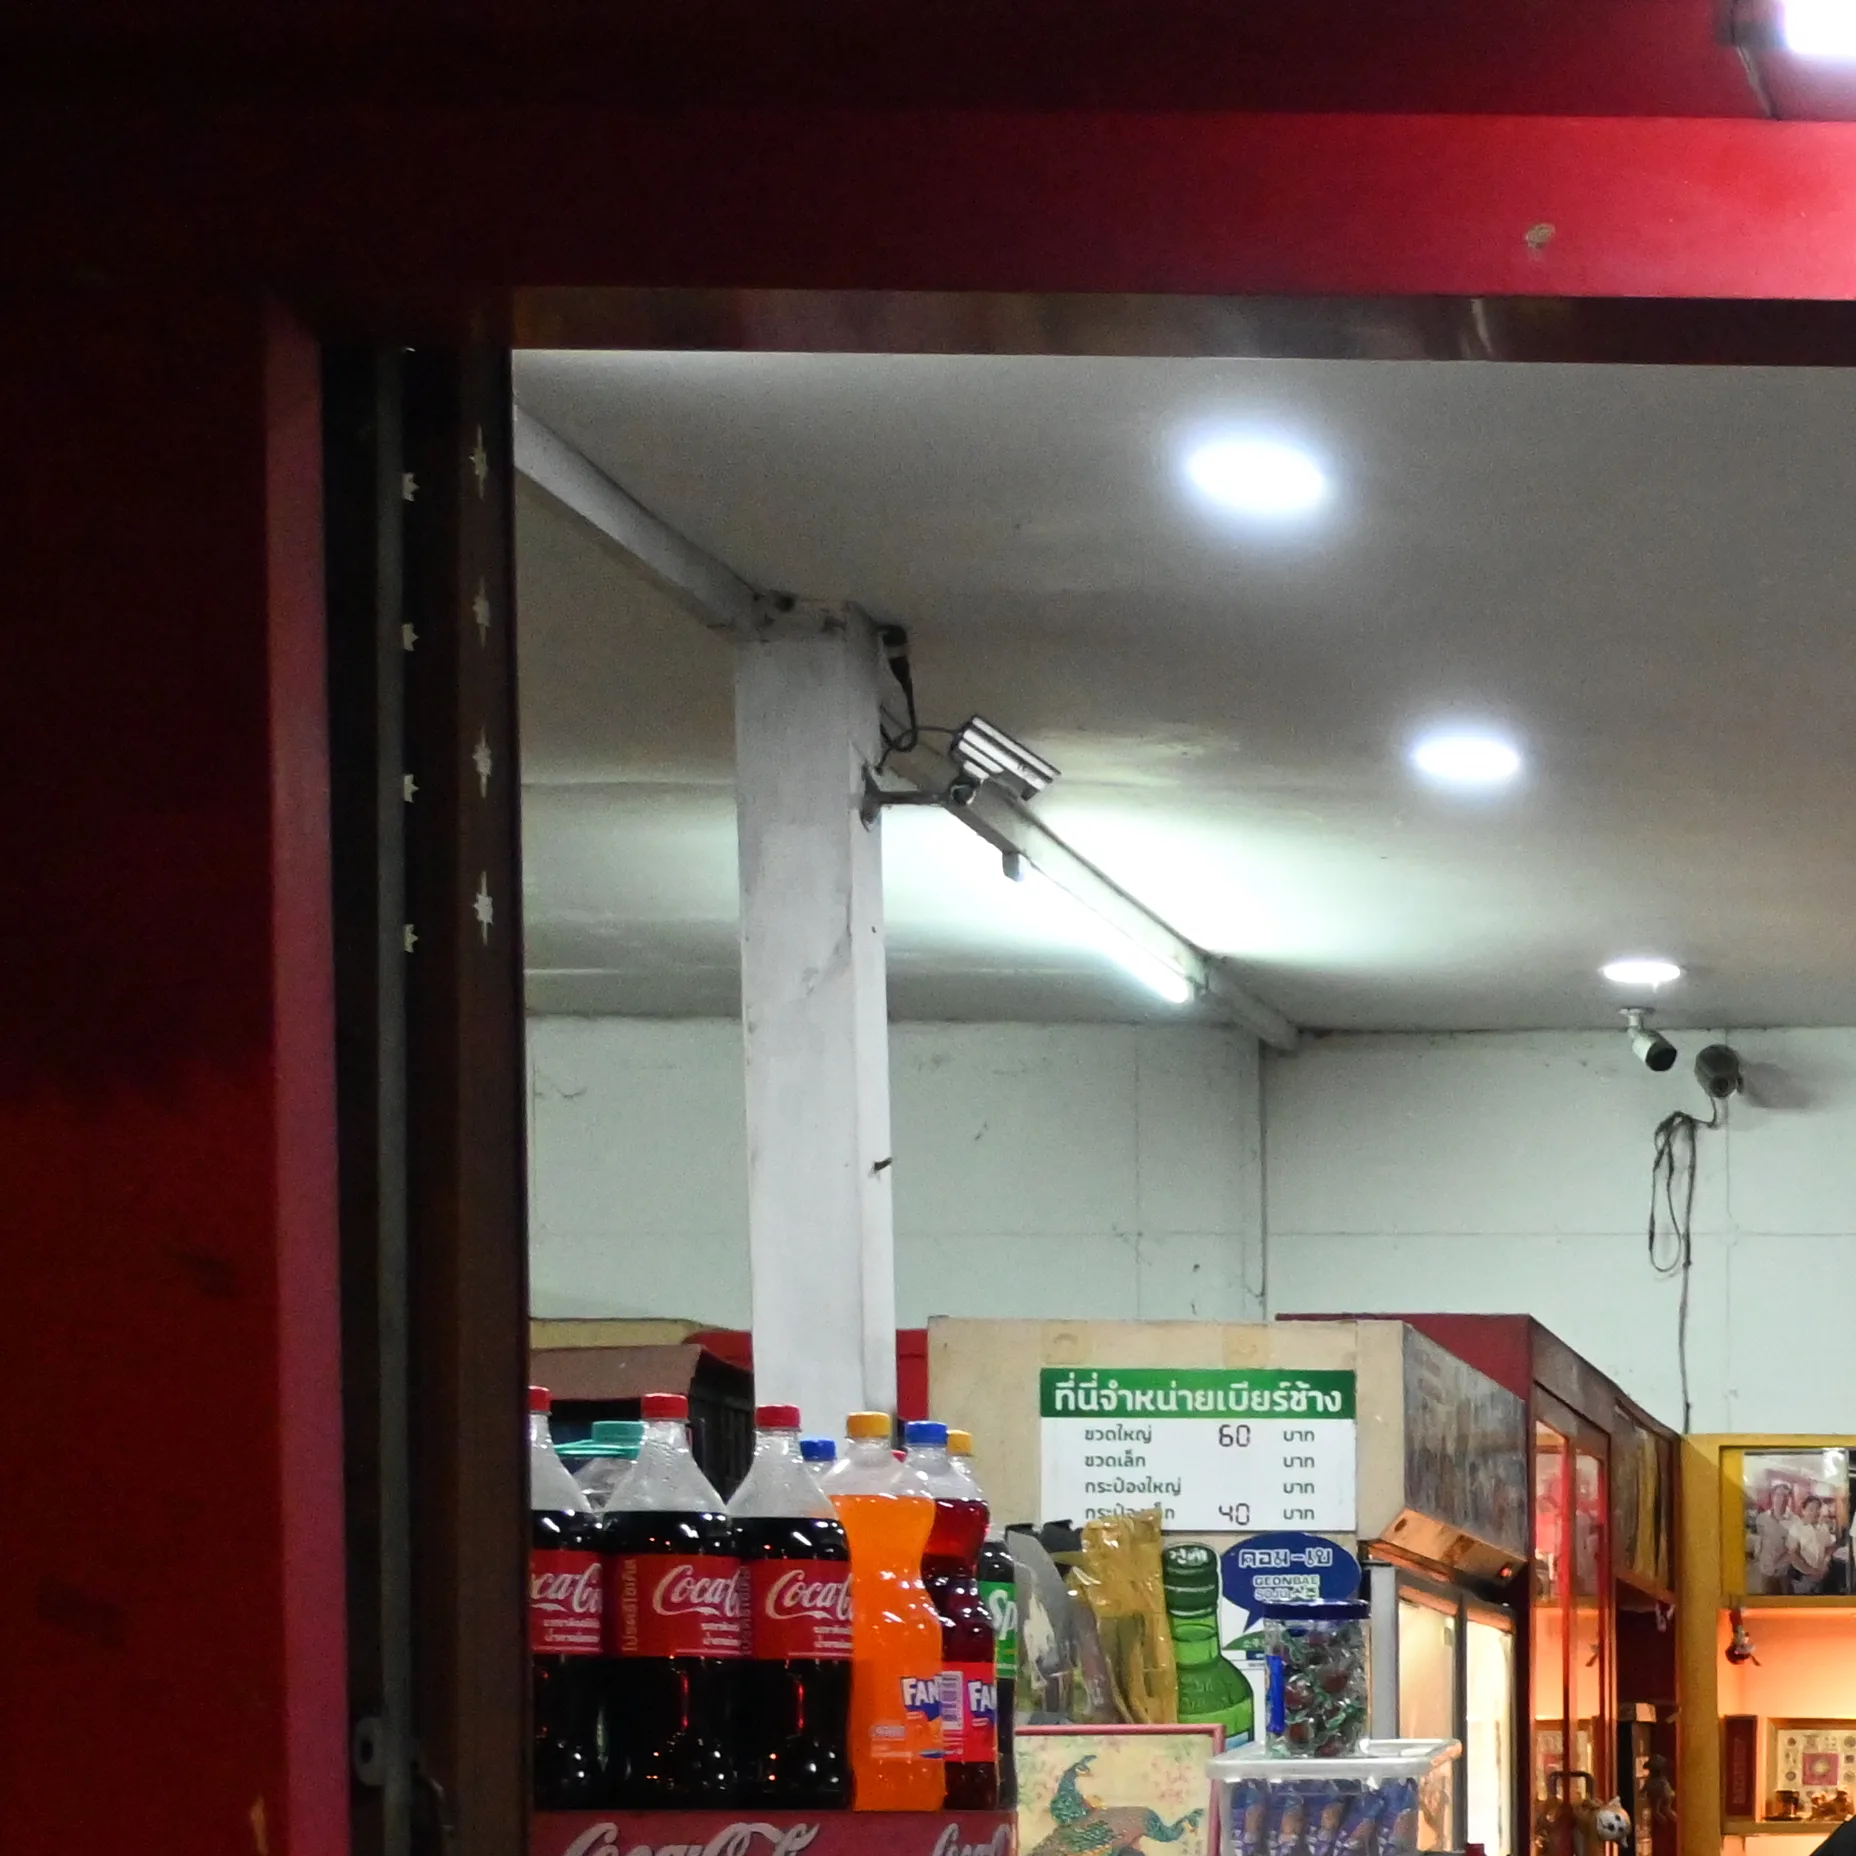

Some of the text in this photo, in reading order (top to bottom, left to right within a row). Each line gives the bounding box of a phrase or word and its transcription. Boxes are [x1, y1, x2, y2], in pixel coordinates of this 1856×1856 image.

[1053, 1372, 1342, 1412] ที่นี่จำหน่ายเบียร์ช้าง
[1084, 1423, 1316, 1448] ขวดใหญ่ 60 บาท
[1084, 1449, 1316, 1469] ขวดเล็ก บาท
[1283, 1480, 1316, 1495] บาท
[1218, 1503, 1251, 1526] 40
[1283, 1506, 1316, 1521] บาท
